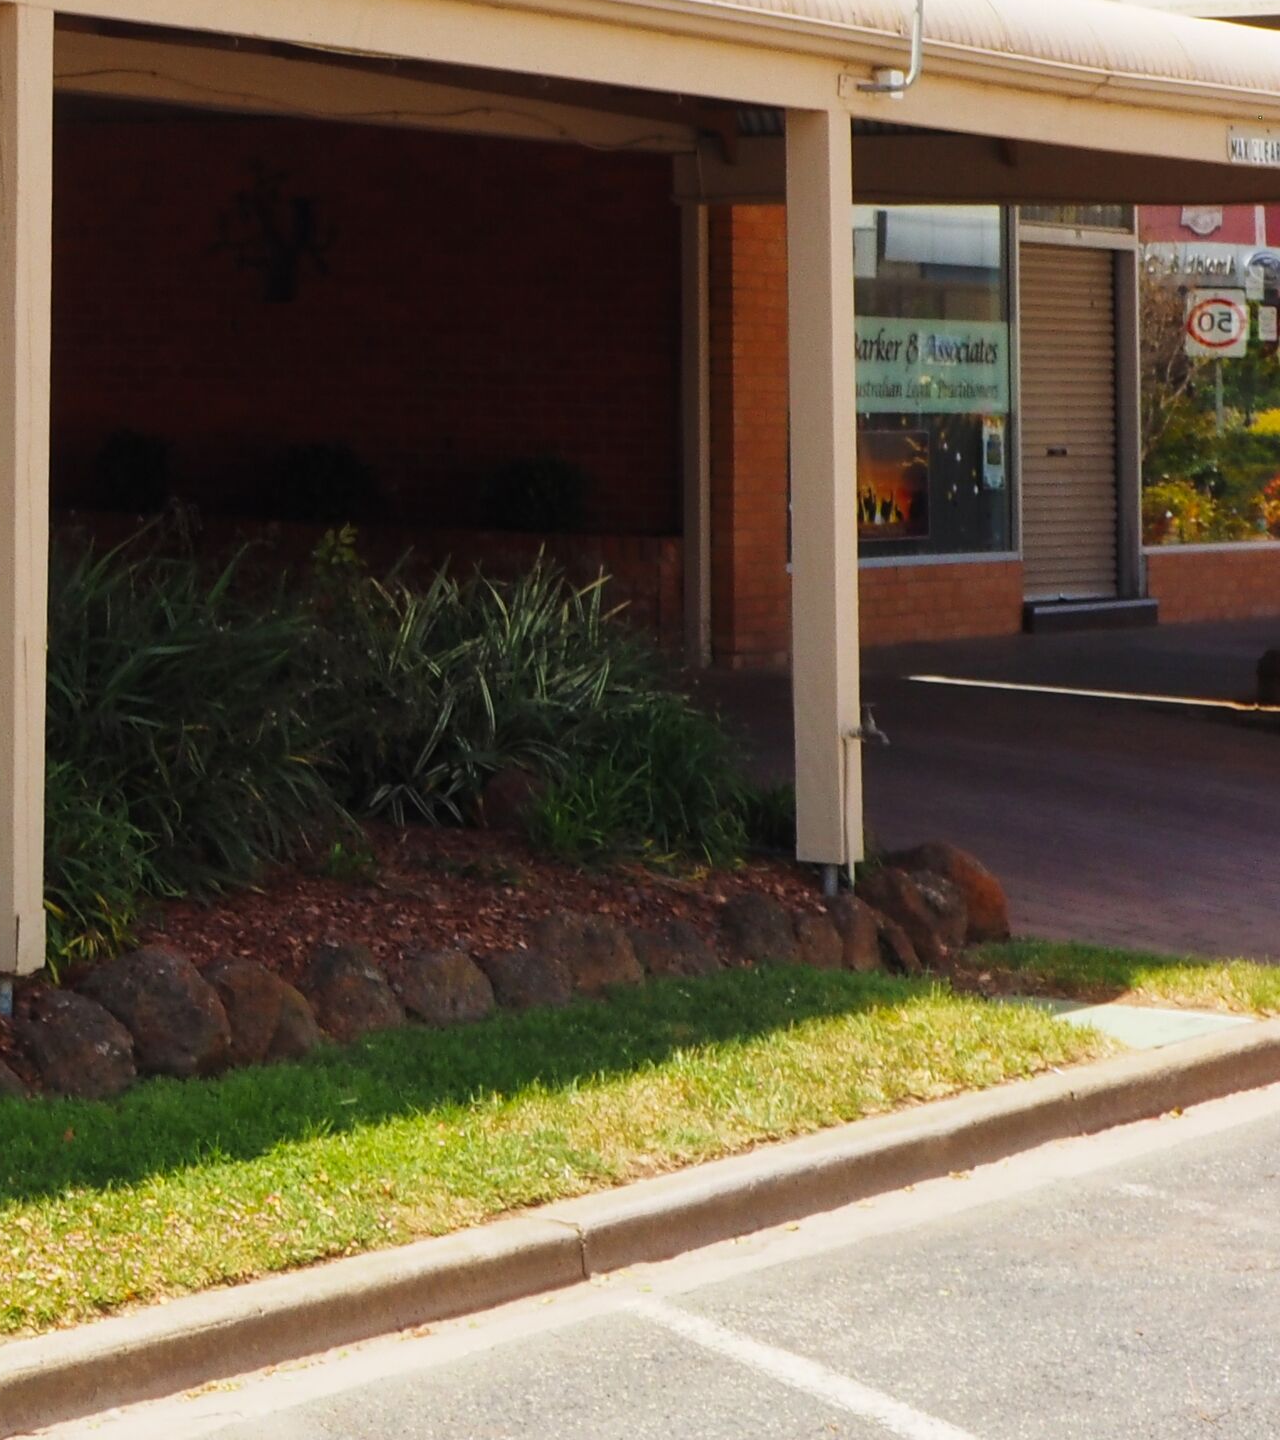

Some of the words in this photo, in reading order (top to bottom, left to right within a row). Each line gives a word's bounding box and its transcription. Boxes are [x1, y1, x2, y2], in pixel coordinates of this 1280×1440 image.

[1231, 139, 1248, 160] MAX
[921, 333, 998, 364] Associates
[855, 376, 902, 398] ustralian
